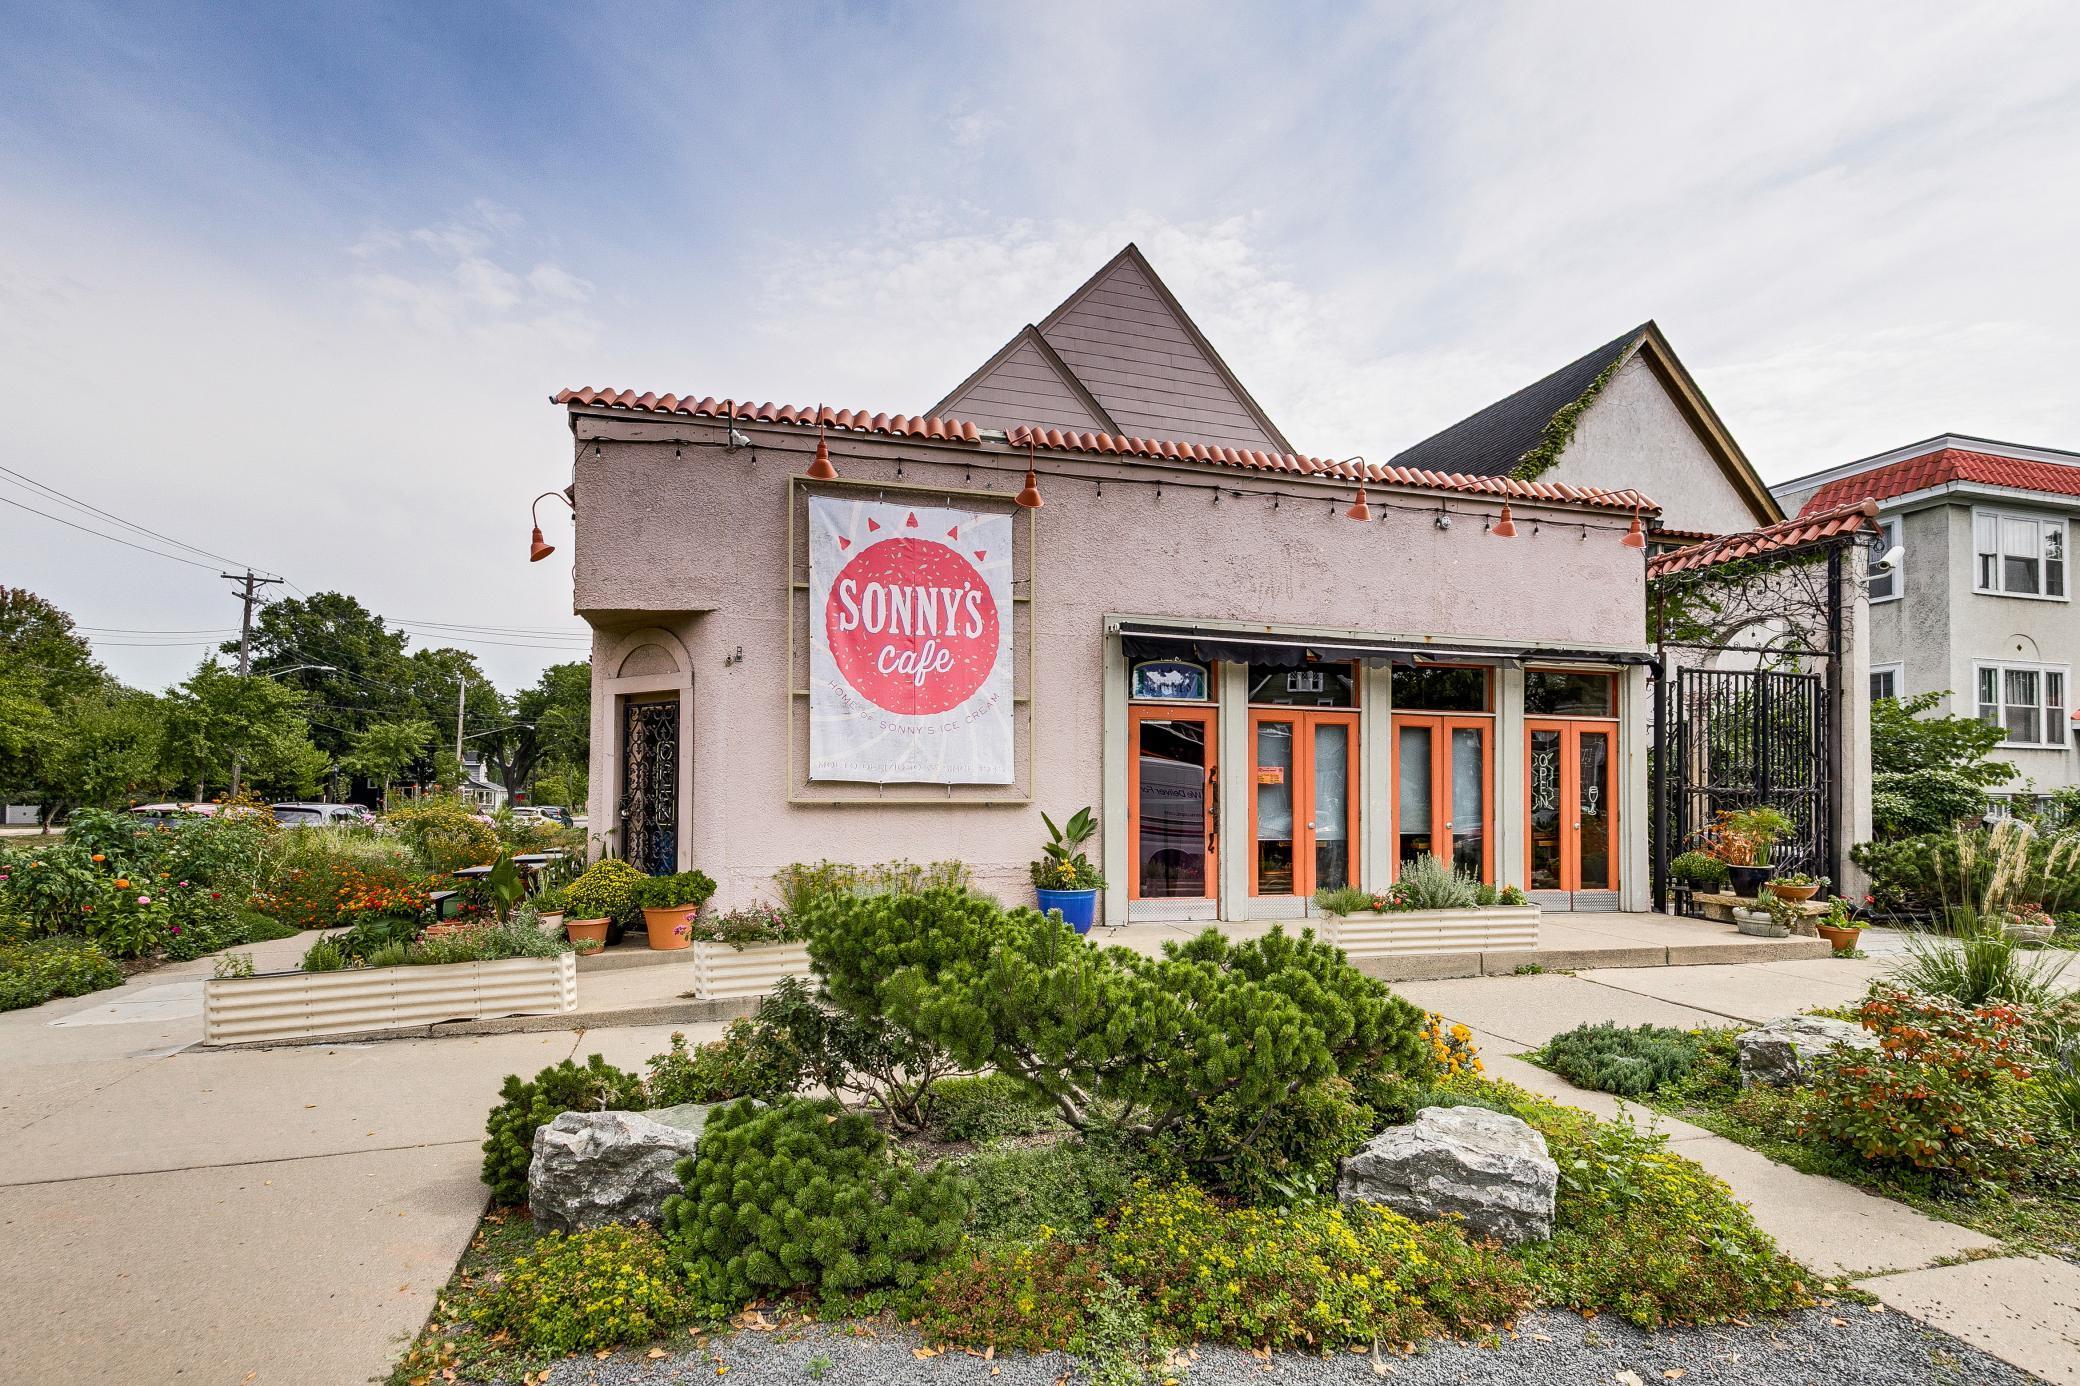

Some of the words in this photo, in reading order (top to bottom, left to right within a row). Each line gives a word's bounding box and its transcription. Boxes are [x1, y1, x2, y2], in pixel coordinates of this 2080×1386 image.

[839, 578, 983, 639] SONNY'S
[827, 680, 857, 710] HOME
[859, 710, 874, 721] OF
[879, 720, 935, 735] SONNY'S
[940, 720, 960, 735] ICE
[965, 691, 1000, 724] CREAM
[1538, 753, 1548, 808] OPEN
